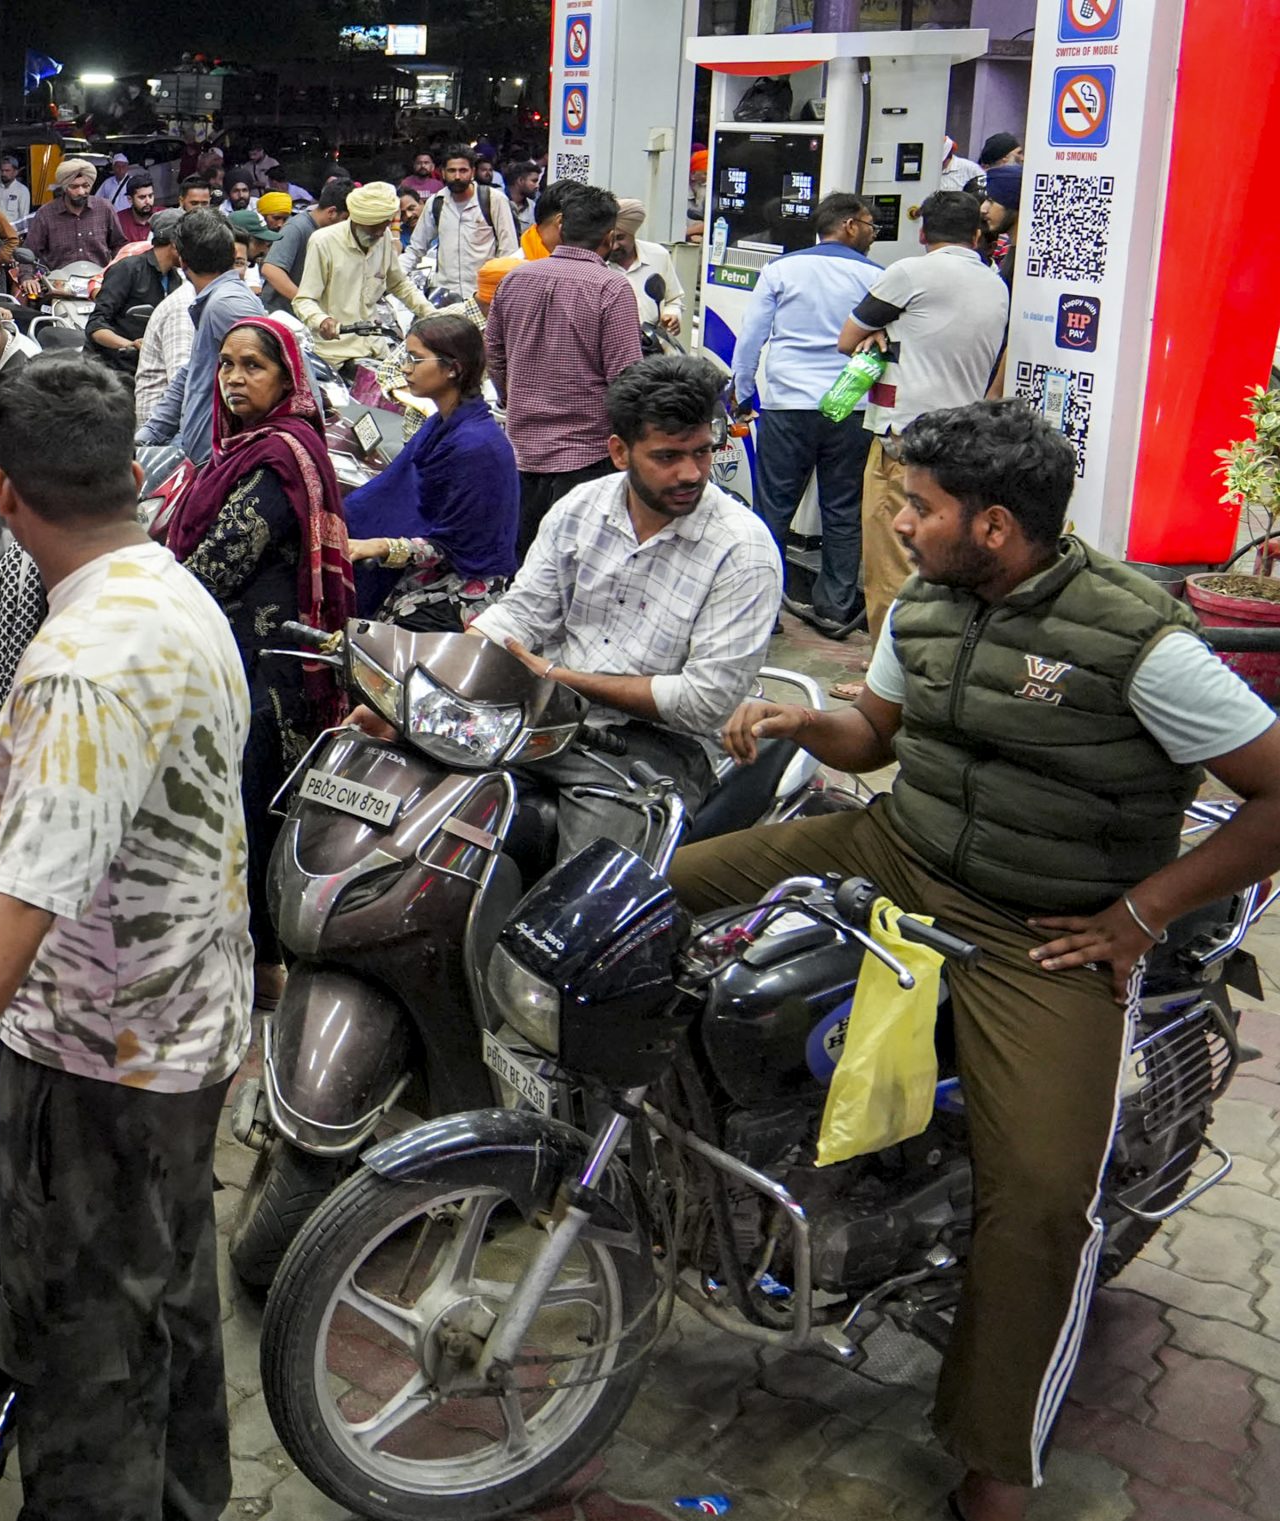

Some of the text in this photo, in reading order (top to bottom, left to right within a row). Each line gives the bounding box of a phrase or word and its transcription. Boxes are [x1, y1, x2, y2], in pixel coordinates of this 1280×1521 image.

[1056, 45, 1119, 58] SWITCH OF MOBILE
[1056, 151, 1098, 162] NO SMOKING
[721, 268, 749, 285] Petrol
[1061, 299, 1097, 315] Happy with
[1067, 312, 1091, 329] HP
[1069, 329, 1084, 339] PAY
[364, 746, 407, 767] HONDA
[306, 778, 391, 818] PB02 CW 8791
[487, 1046, 546, 1109] PB02 BE 2436
